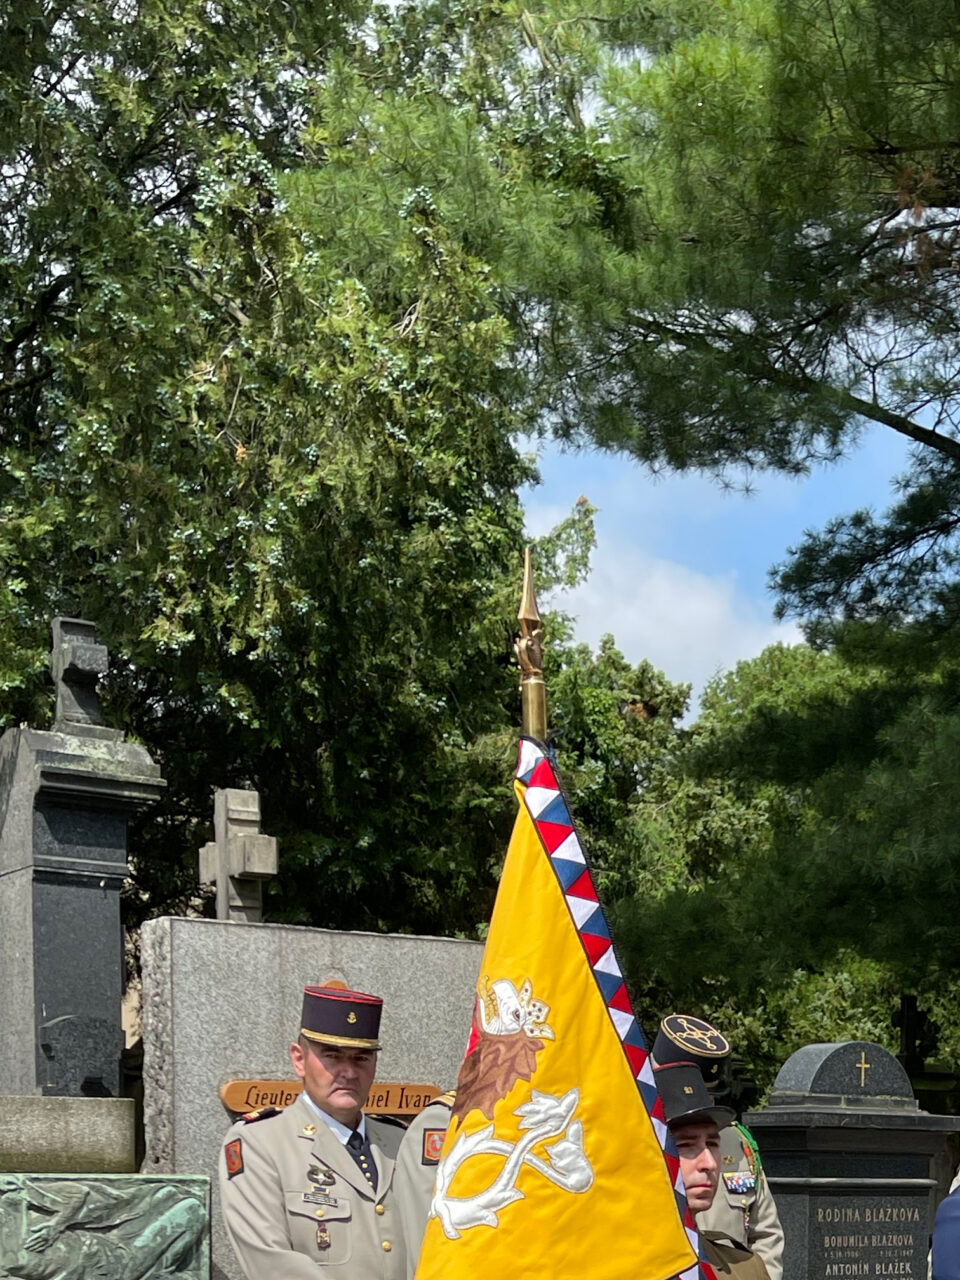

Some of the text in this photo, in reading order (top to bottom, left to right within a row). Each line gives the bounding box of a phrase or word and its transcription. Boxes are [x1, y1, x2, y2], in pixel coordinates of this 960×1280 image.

[818, 1208, 860, 1223] RODINA
[824, 1235, 869, 1248] BOHUMILA
[825, 1259, 912, 1276] ANTONÍN BLAŽEK
